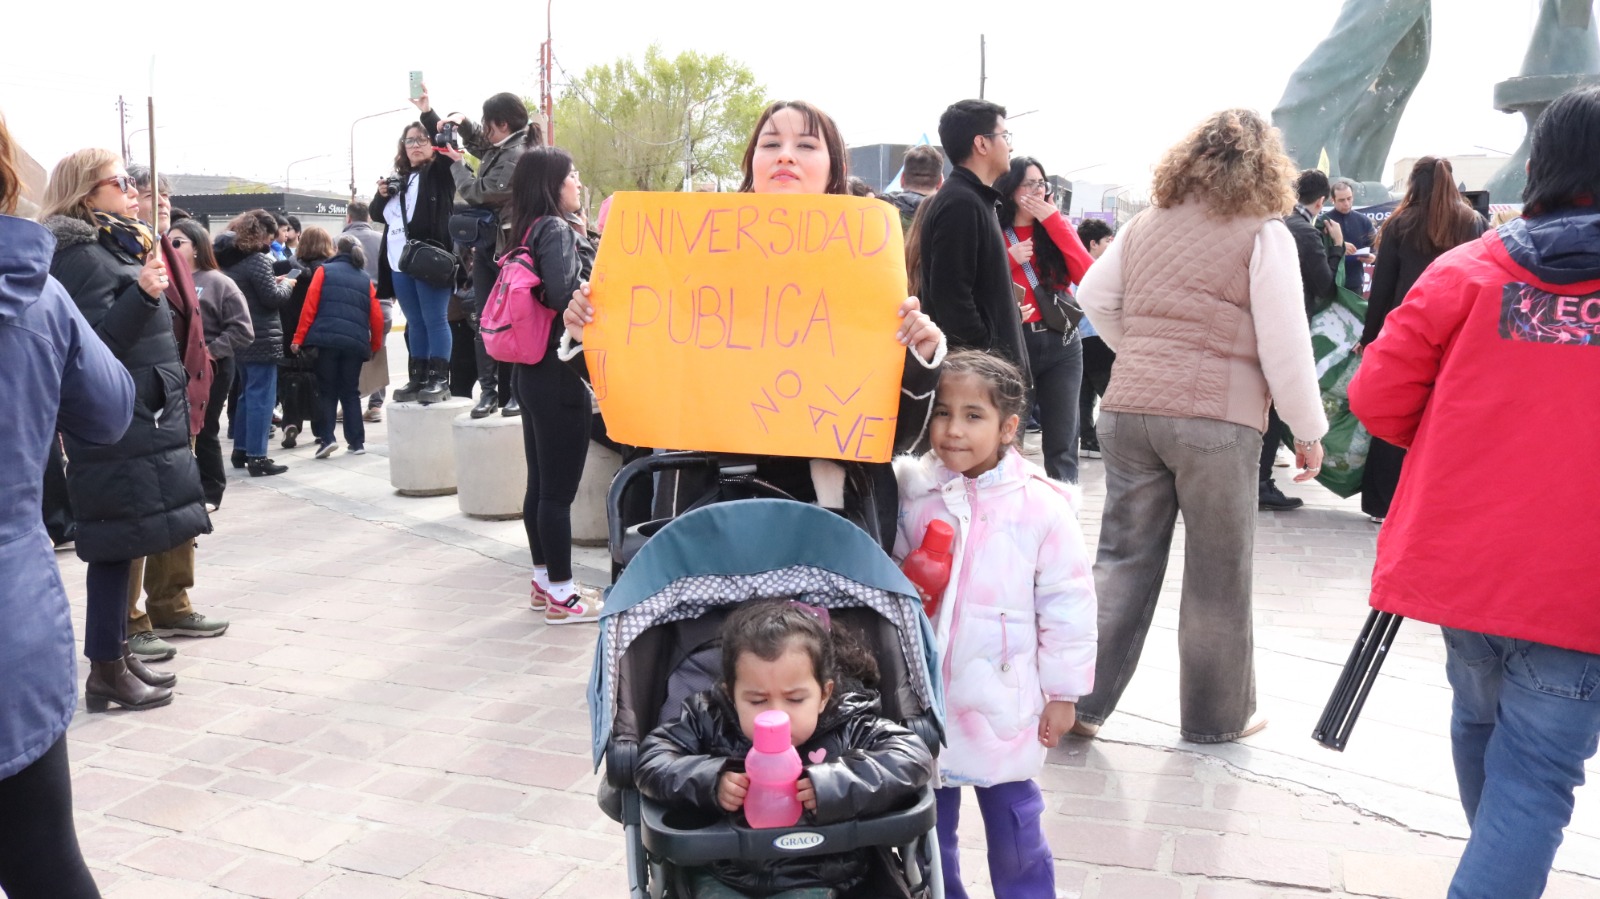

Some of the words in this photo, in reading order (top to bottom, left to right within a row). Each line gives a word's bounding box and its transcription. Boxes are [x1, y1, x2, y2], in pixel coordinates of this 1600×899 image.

[620, 205, 891, 260] UNIVERSIDAD
[626, 274, 835, 358] PÚBLICA
[750, 369, 802, 434] NO
[780, 836, 820, 846] GRACO
